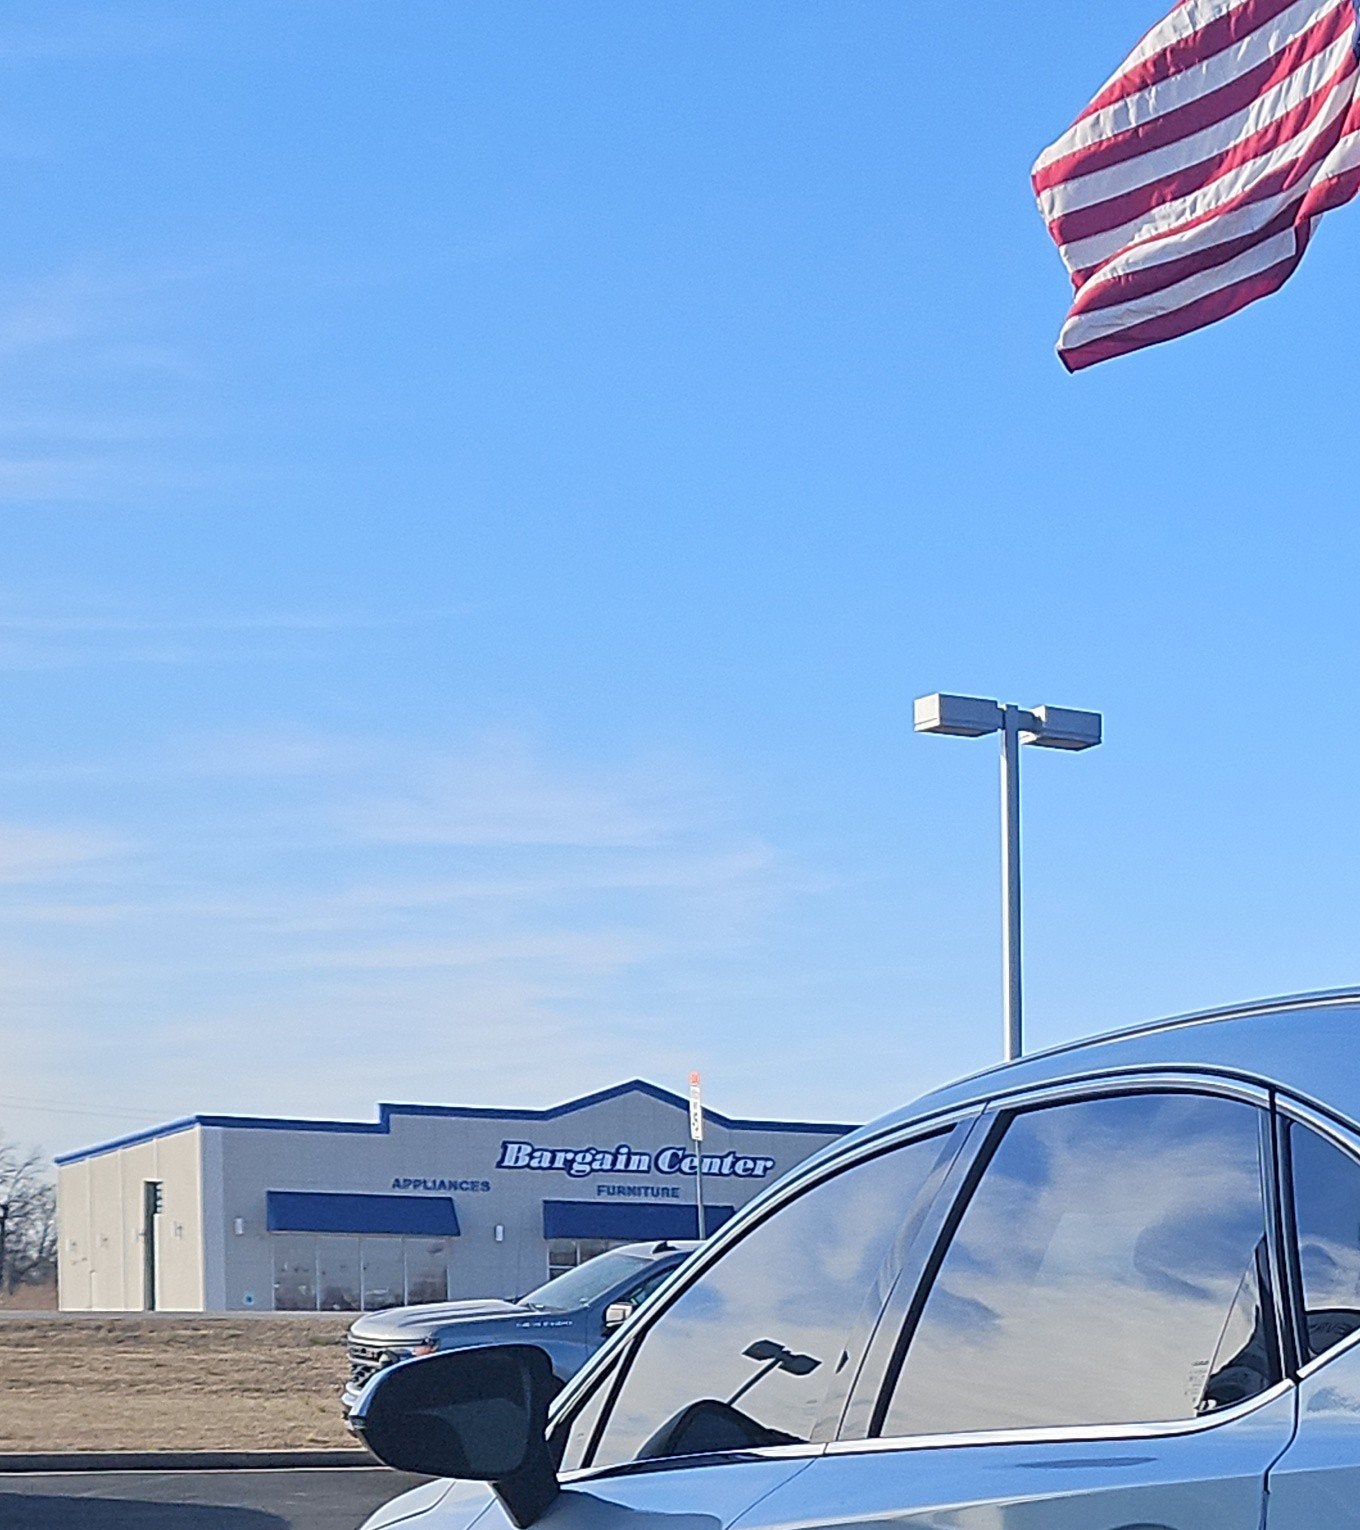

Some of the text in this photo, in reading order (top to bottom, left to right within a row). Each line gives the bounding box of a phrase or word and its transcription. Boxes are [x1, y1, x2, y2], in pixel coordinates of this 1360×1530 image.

[497, 1140, 775, 1178] Bargain Center
[392, 1178, 491, 1192] APPLIANCES
[596, 1185, 680, 1198] FURNITURE
